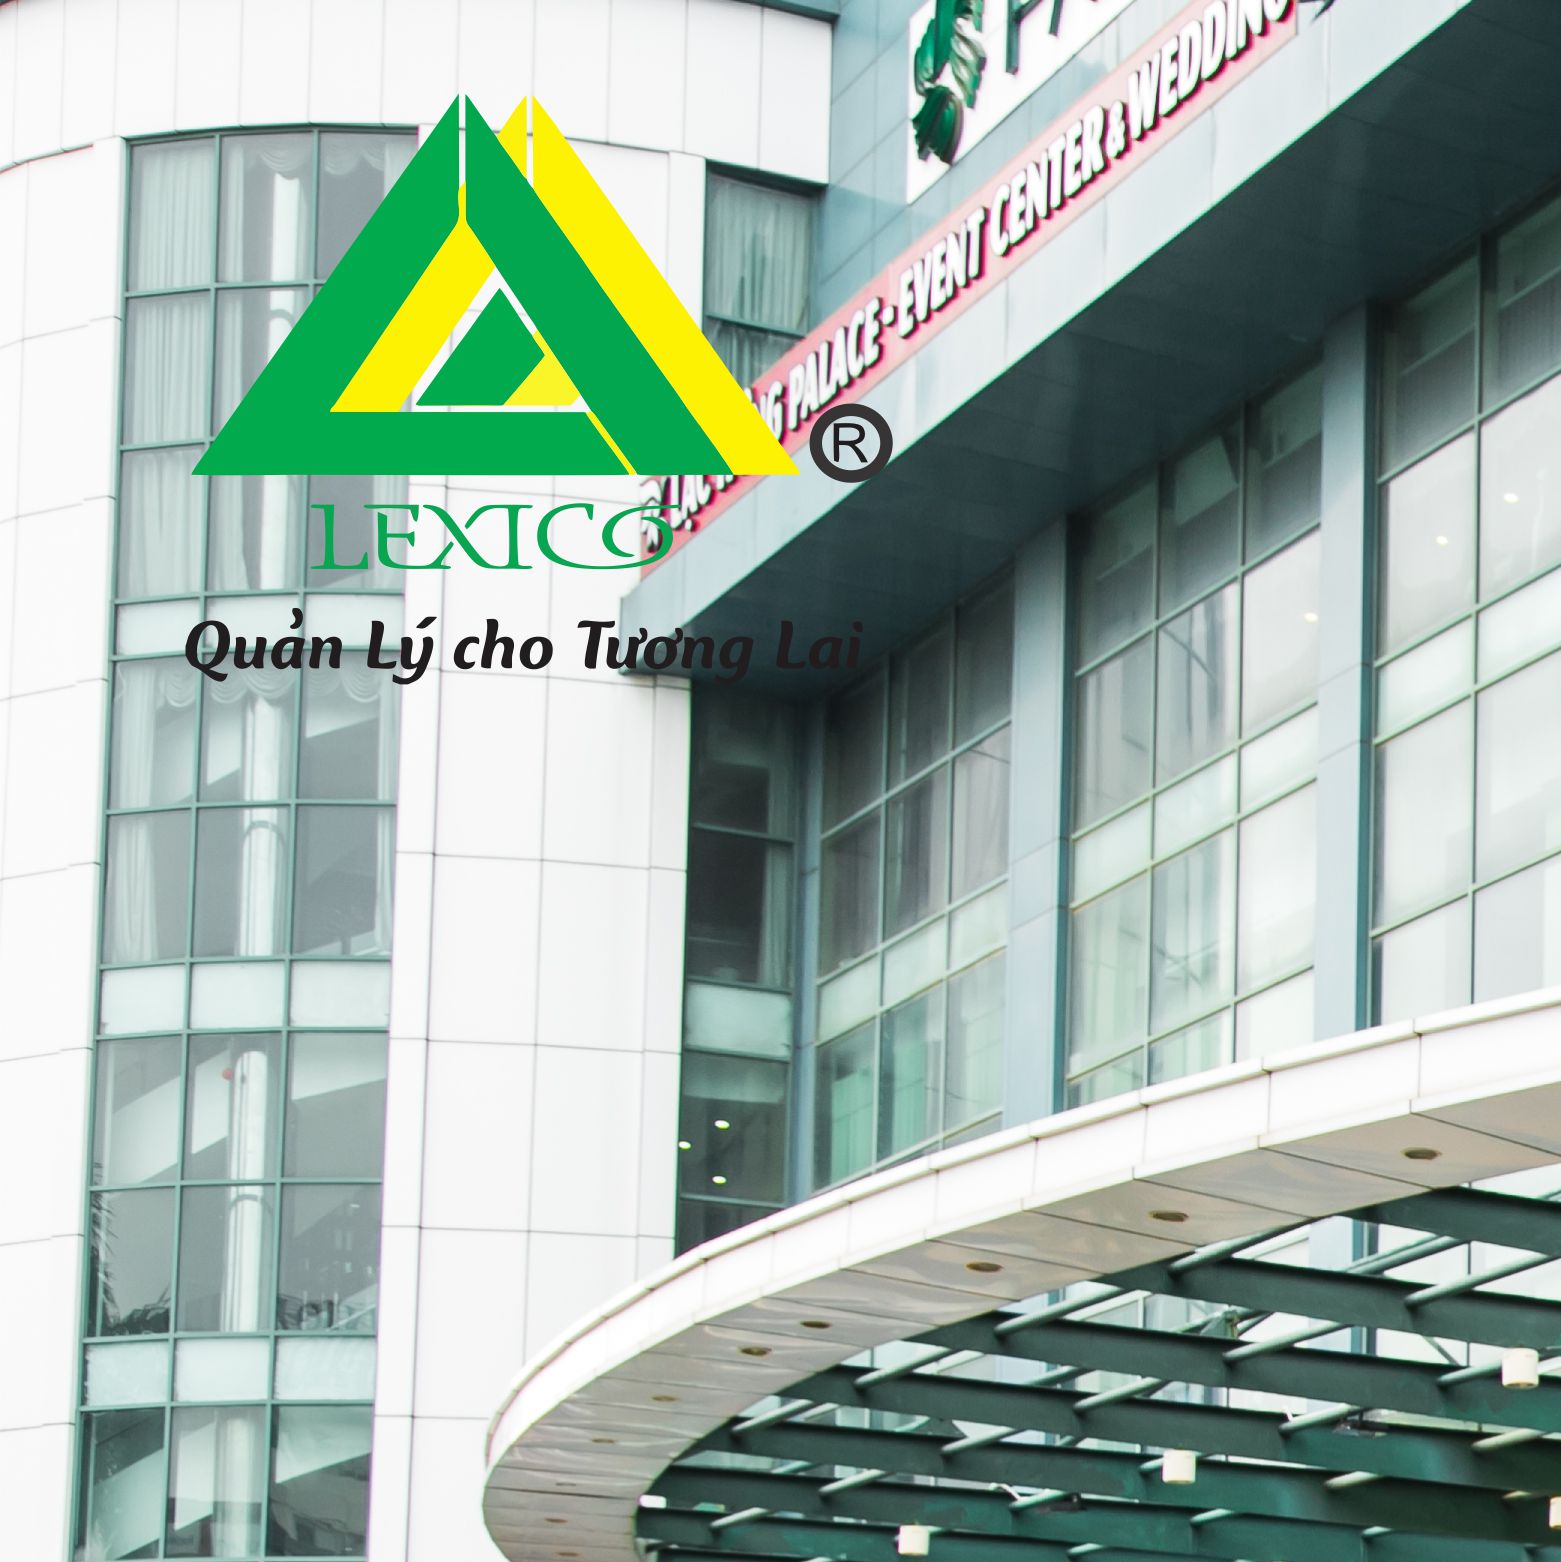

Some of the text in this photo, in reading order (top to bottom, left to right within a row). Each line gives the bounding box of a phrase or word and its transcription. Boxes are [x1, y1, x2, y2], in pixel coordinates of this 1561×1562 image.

[788, 297, 881, 431] PALACE
[899, 207, 986, 338] EVENT
[989, 105, 1107, 257] CENTER
[1106, 100, 1126, 158] &
